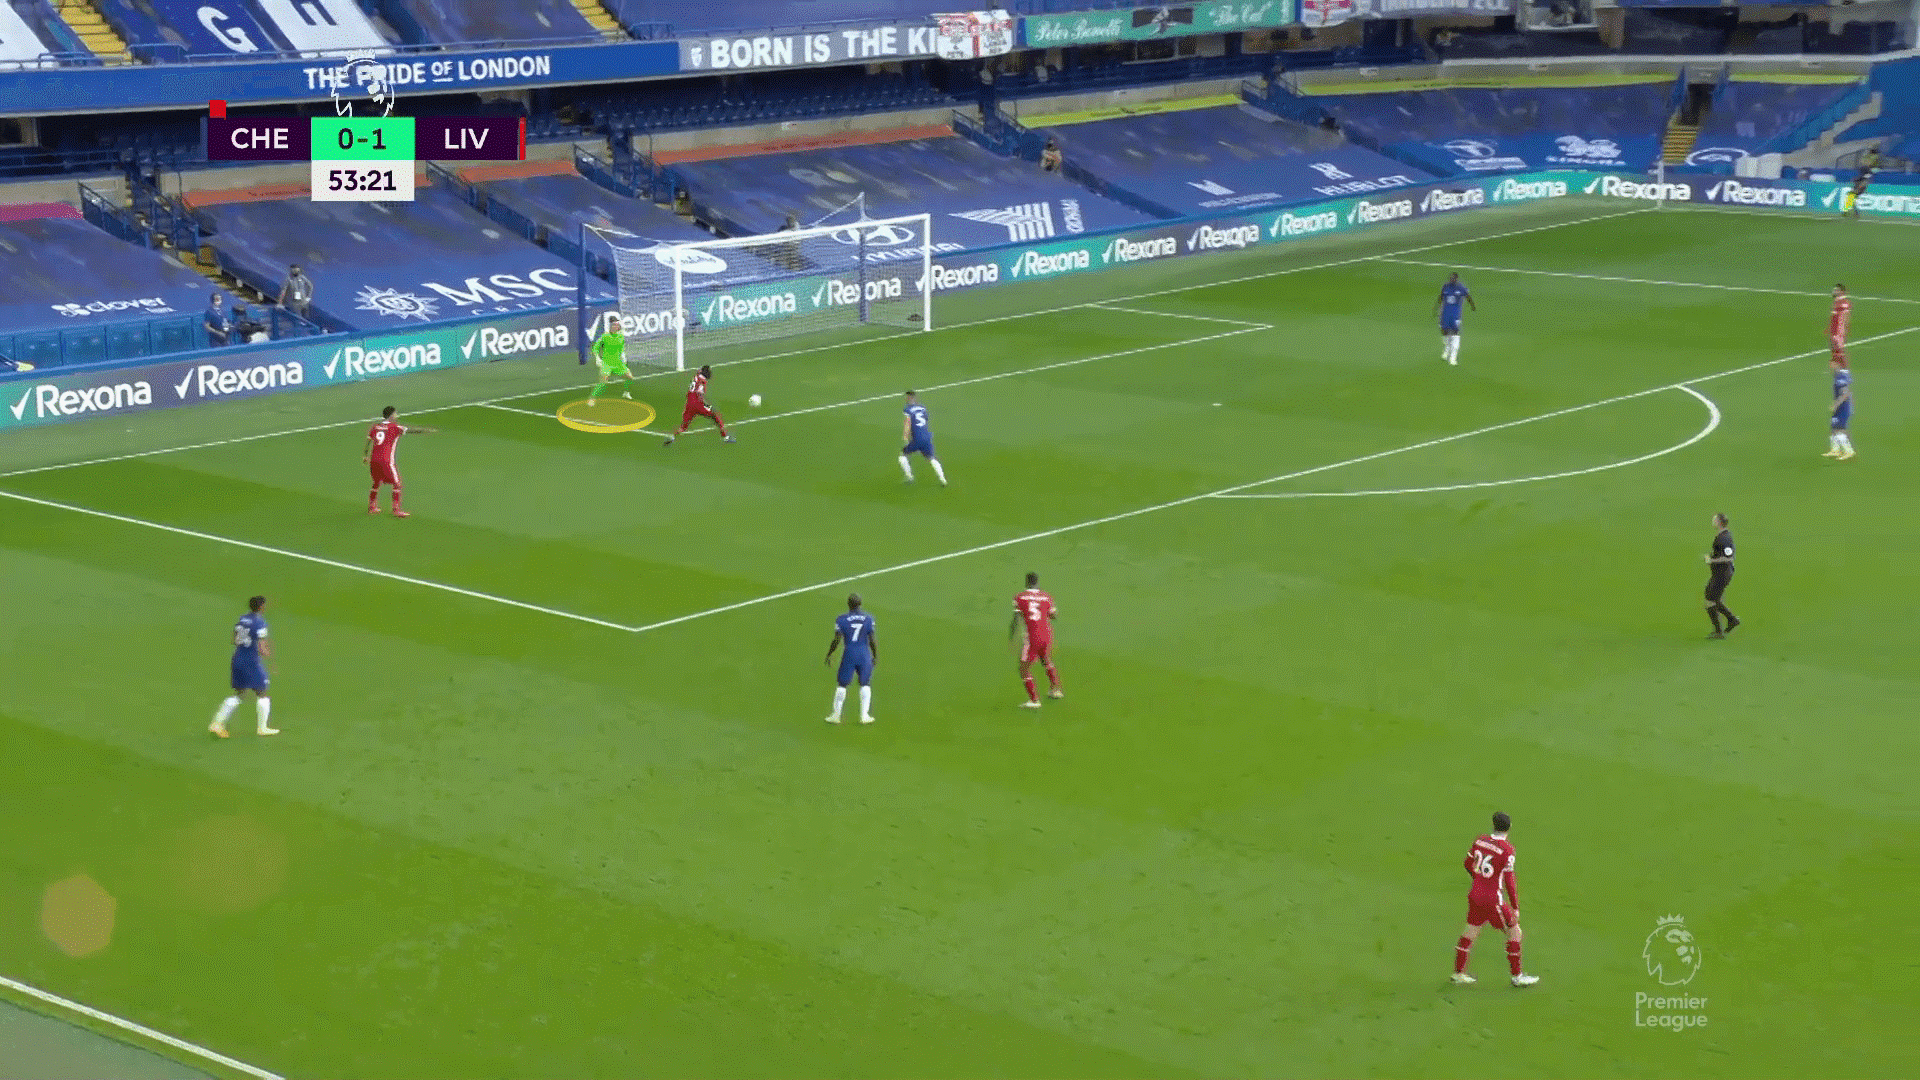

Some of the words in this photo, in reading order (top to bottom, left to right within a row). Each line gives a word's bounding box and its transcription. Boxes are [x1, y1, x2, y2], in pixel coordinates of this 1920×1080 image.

[710, 37, 793, 68] BORN
[804, 35, 831, 63] IS
[842, 27, 897, 58] THE
[303, 66, 350, 90] THE
[356, 62, 426, 87] PRIDE
[431, 61, 454, 76] OF
[458, 55, 551, 81] LONDON
[1431, 188, 1484, 212] Rexona
[1504, 179, 1567, 200] Rexona
[1602, 176, 1691, 201] Rexona
[1723, 180, 1806, 207] Rexona
[1281, 211, 1337, 236] Rexona
[1359, 199, 1412, 225] Rexona
[1114, 236, 1176, 263] Rexona
[1202, 224, 1259, 250] Rexona
[1025, 249, 1089, 276] Rexona
[420, 268, 579, 306] MSC
[827, 275, 902, 305] Rexona
[931, 263, 998, 290] Rexona
[719, 292, 796, 323] Rexona
[480, 324, 569, 357] Rexona
[344, 343, 441, 377] Rexona
[198, 361, 303, 397] Rexona
[36, 381, 152, 418] Rexona
[915, 412, 926, 427] 5
[376, 431, 385, 446] 9
[1028, 601, 1041, 621] 5
[851, 623, 863, 642] 7
[1472, 849, 1495, 879] 26
